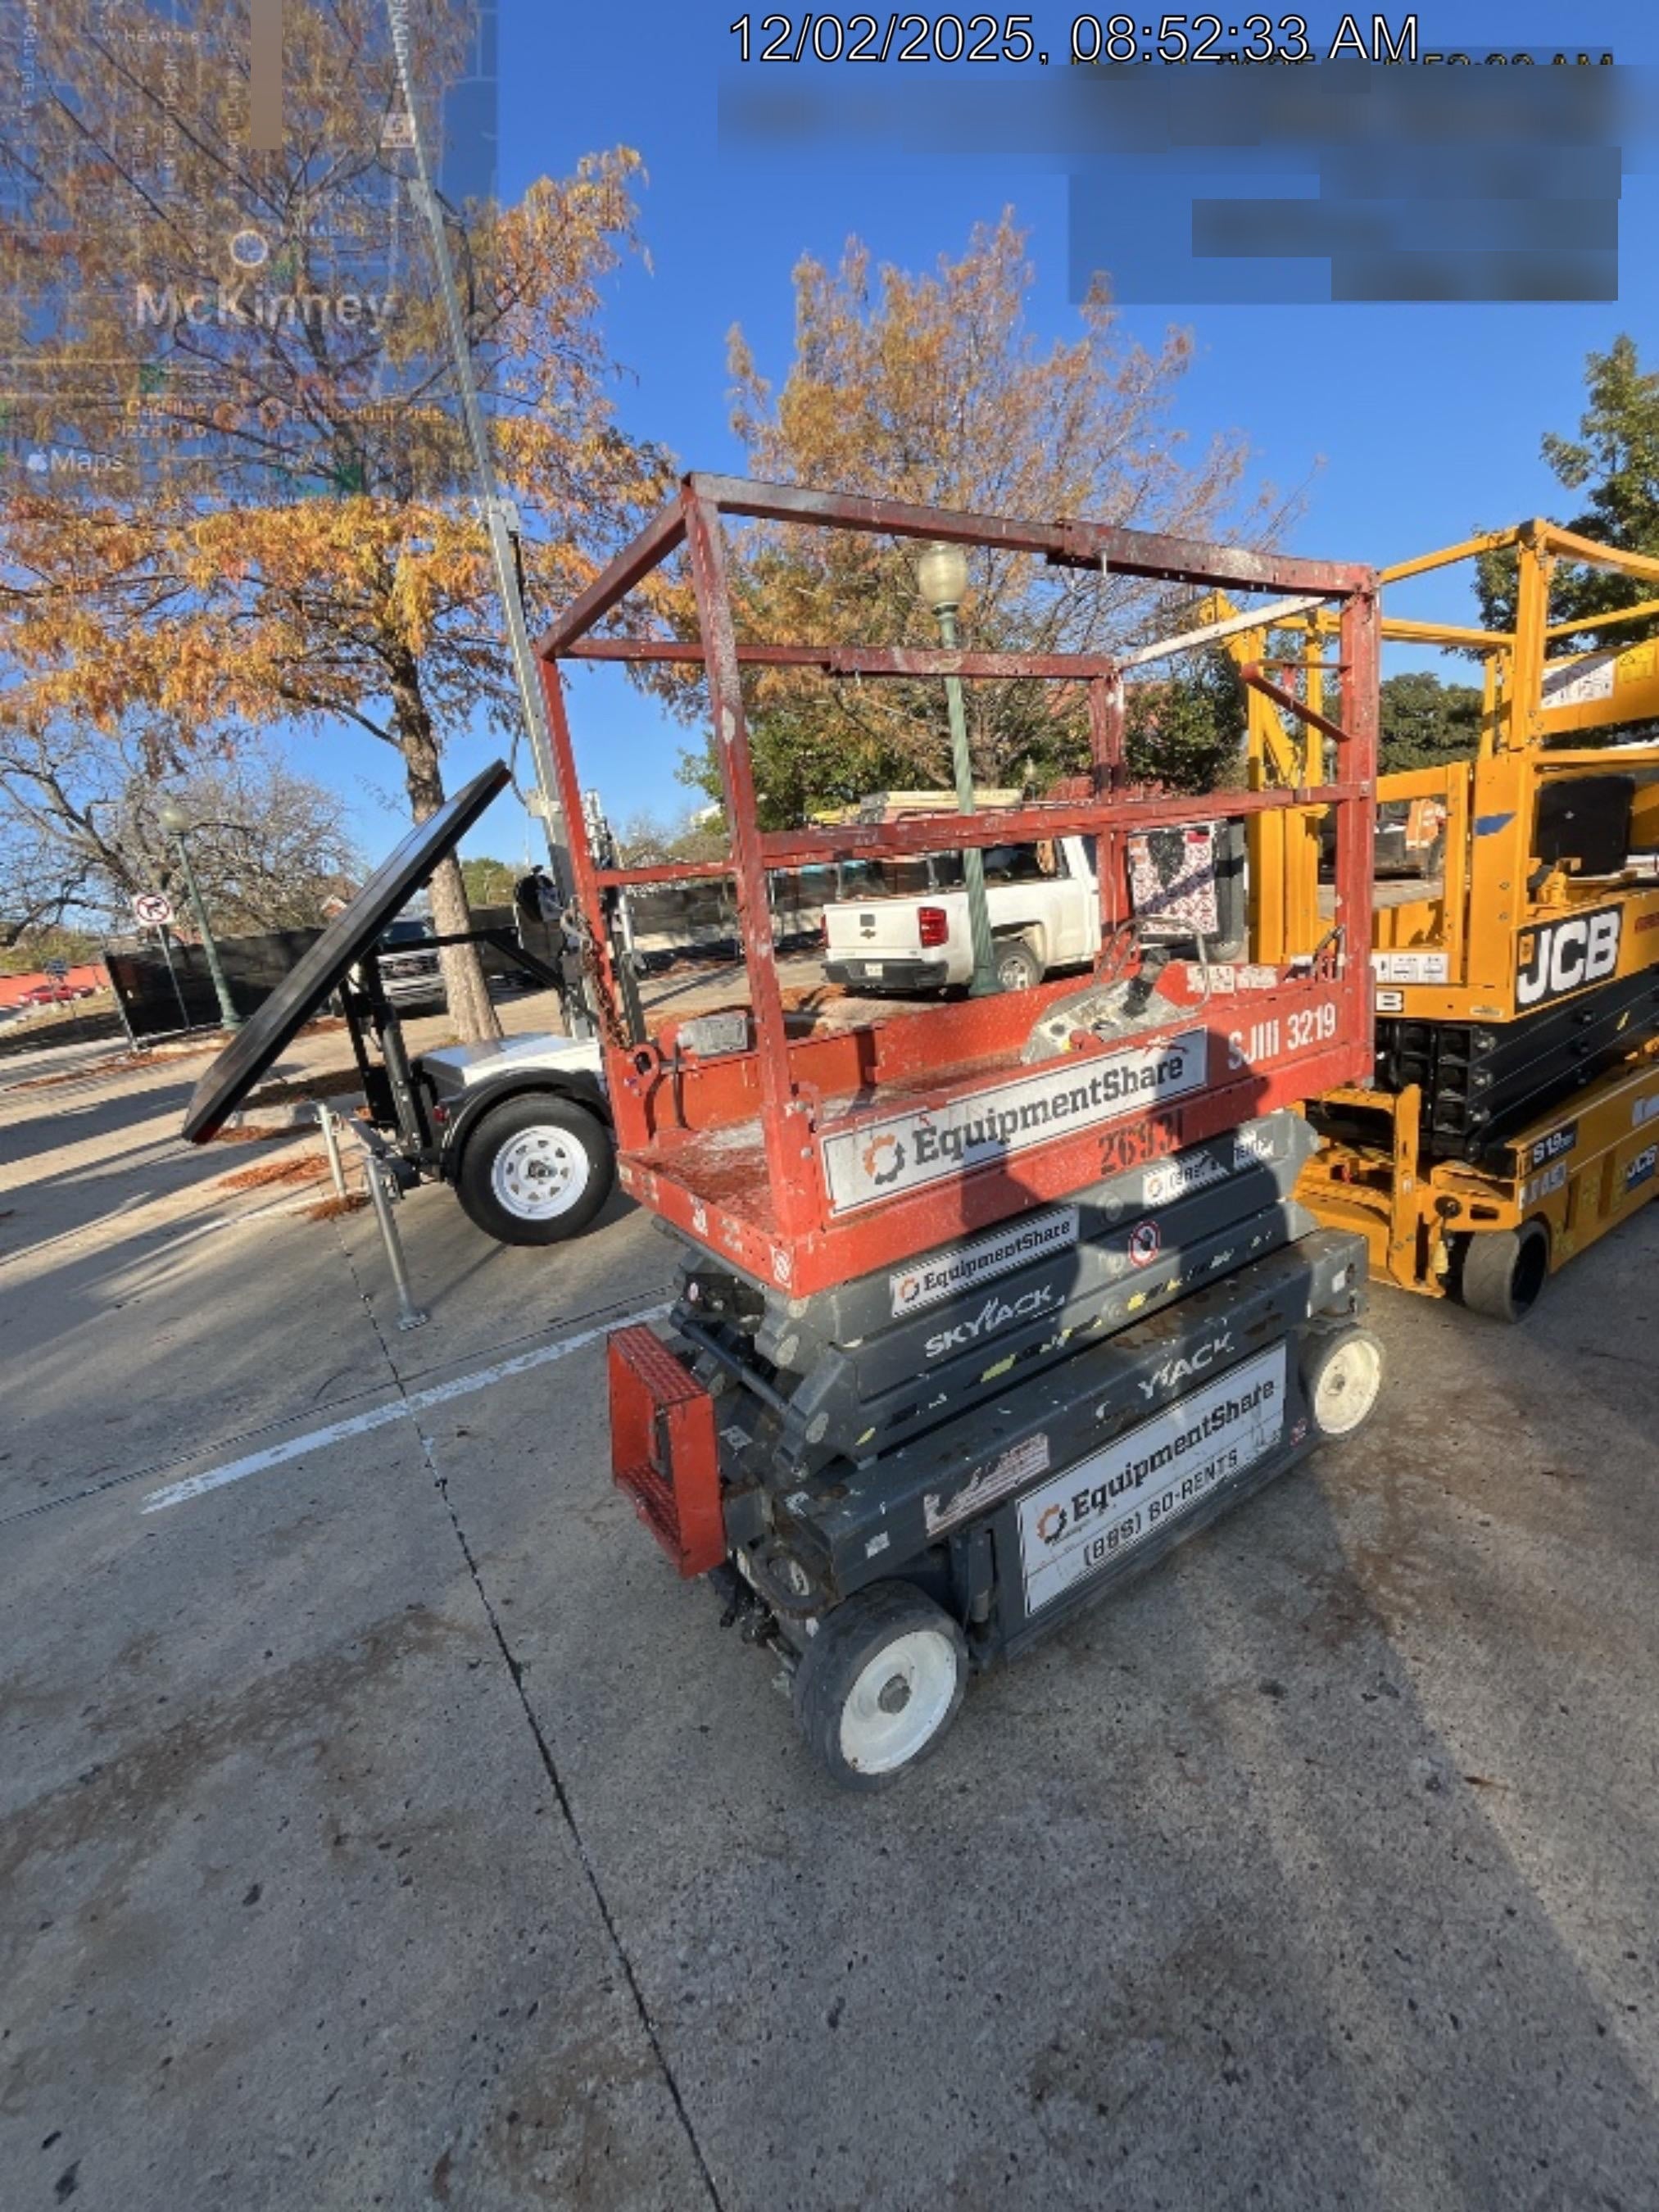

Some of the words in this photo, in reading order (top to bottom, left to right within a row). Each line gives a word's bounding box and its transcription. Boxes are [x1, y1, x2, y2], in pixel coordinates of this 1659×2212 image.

[1518, 911, 1619, 1004] JCB
[1287, 1002, 1336, 1050] 3219
[912, 1055, 1184, 1166] EquipmentShare
[922, 1221, 1071, 1292] EquipmentShare
[923, 1283, 1053, 1358] SKYJACK
[1071, 1380, 1276, 1522] EquipmentShare
